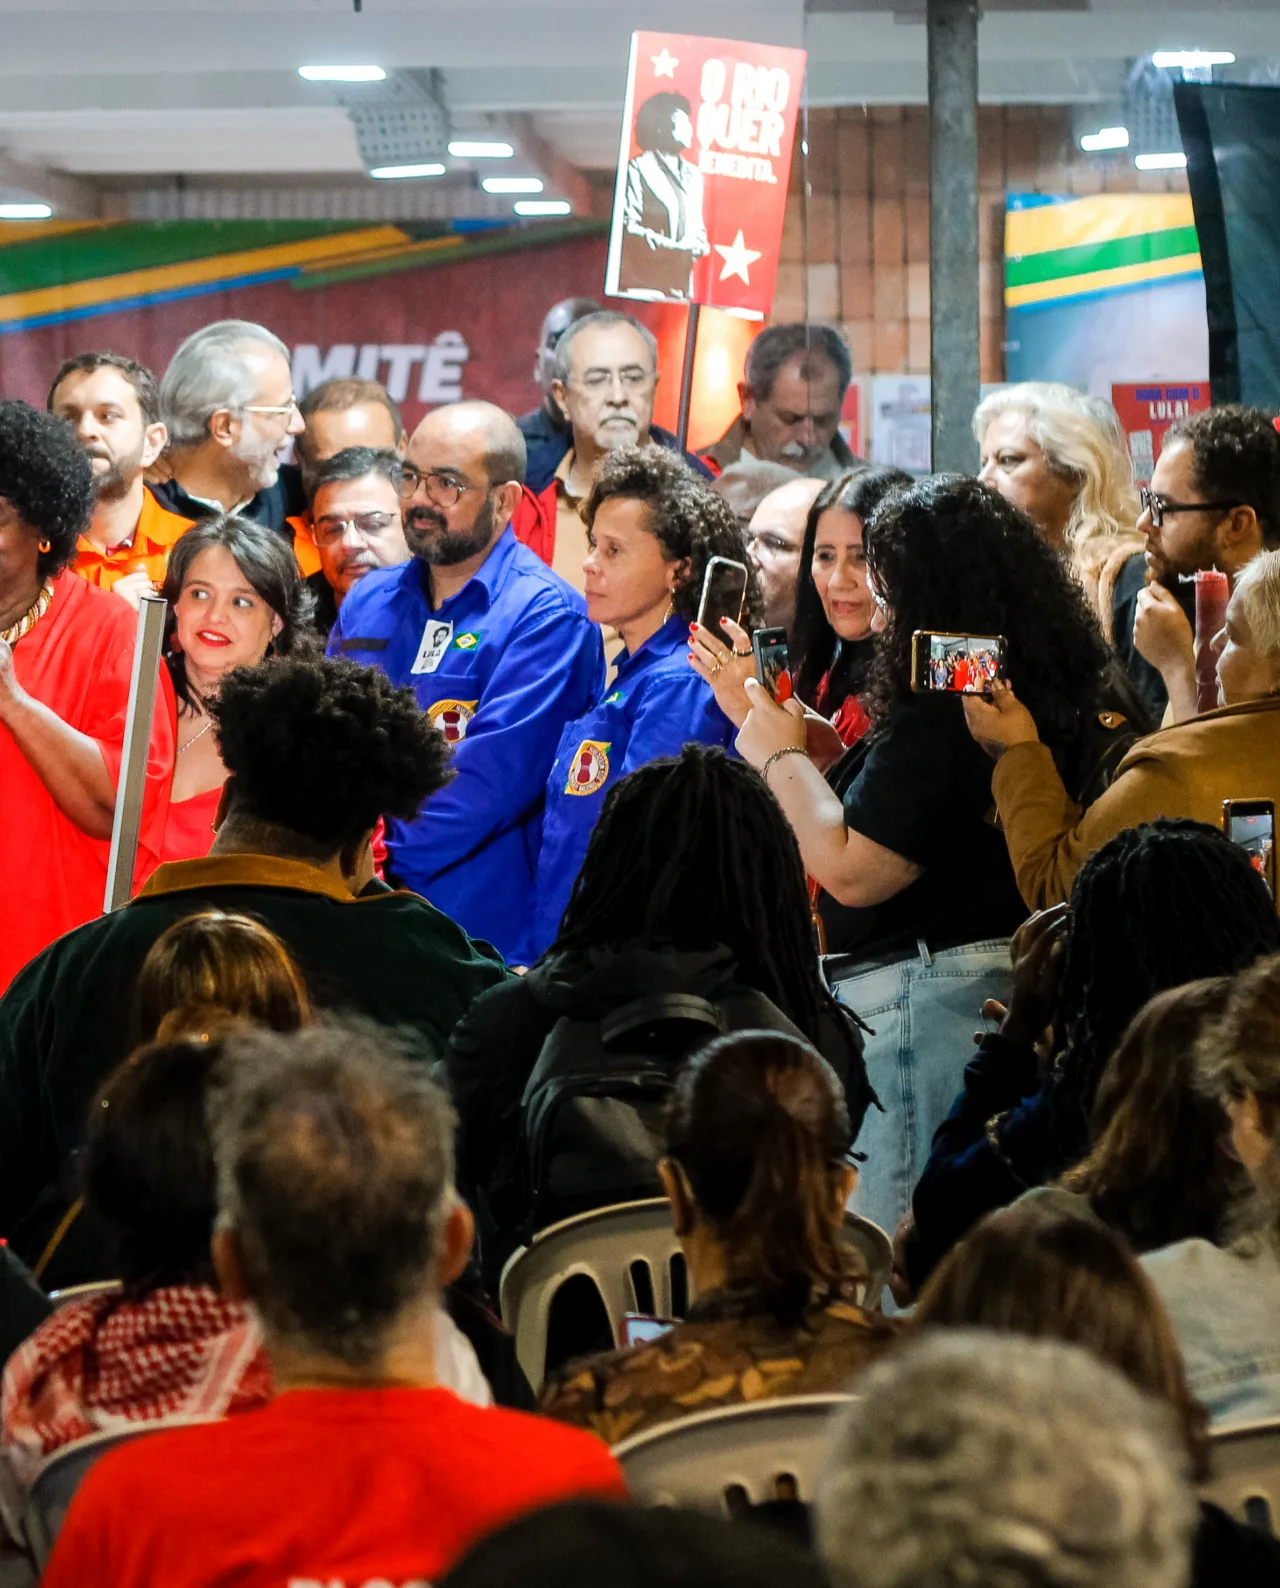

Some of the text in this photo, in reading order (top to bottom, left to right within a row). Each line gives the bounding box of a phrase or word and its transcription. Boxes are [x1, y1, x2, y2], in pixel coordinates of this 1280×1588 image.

[700, 58, 790, 112] O RIO
[696, 102, 785, 157] QUER
[291, 331, 469, 404] MITÊ
[1149, 400, 1189, 419] LULA!
